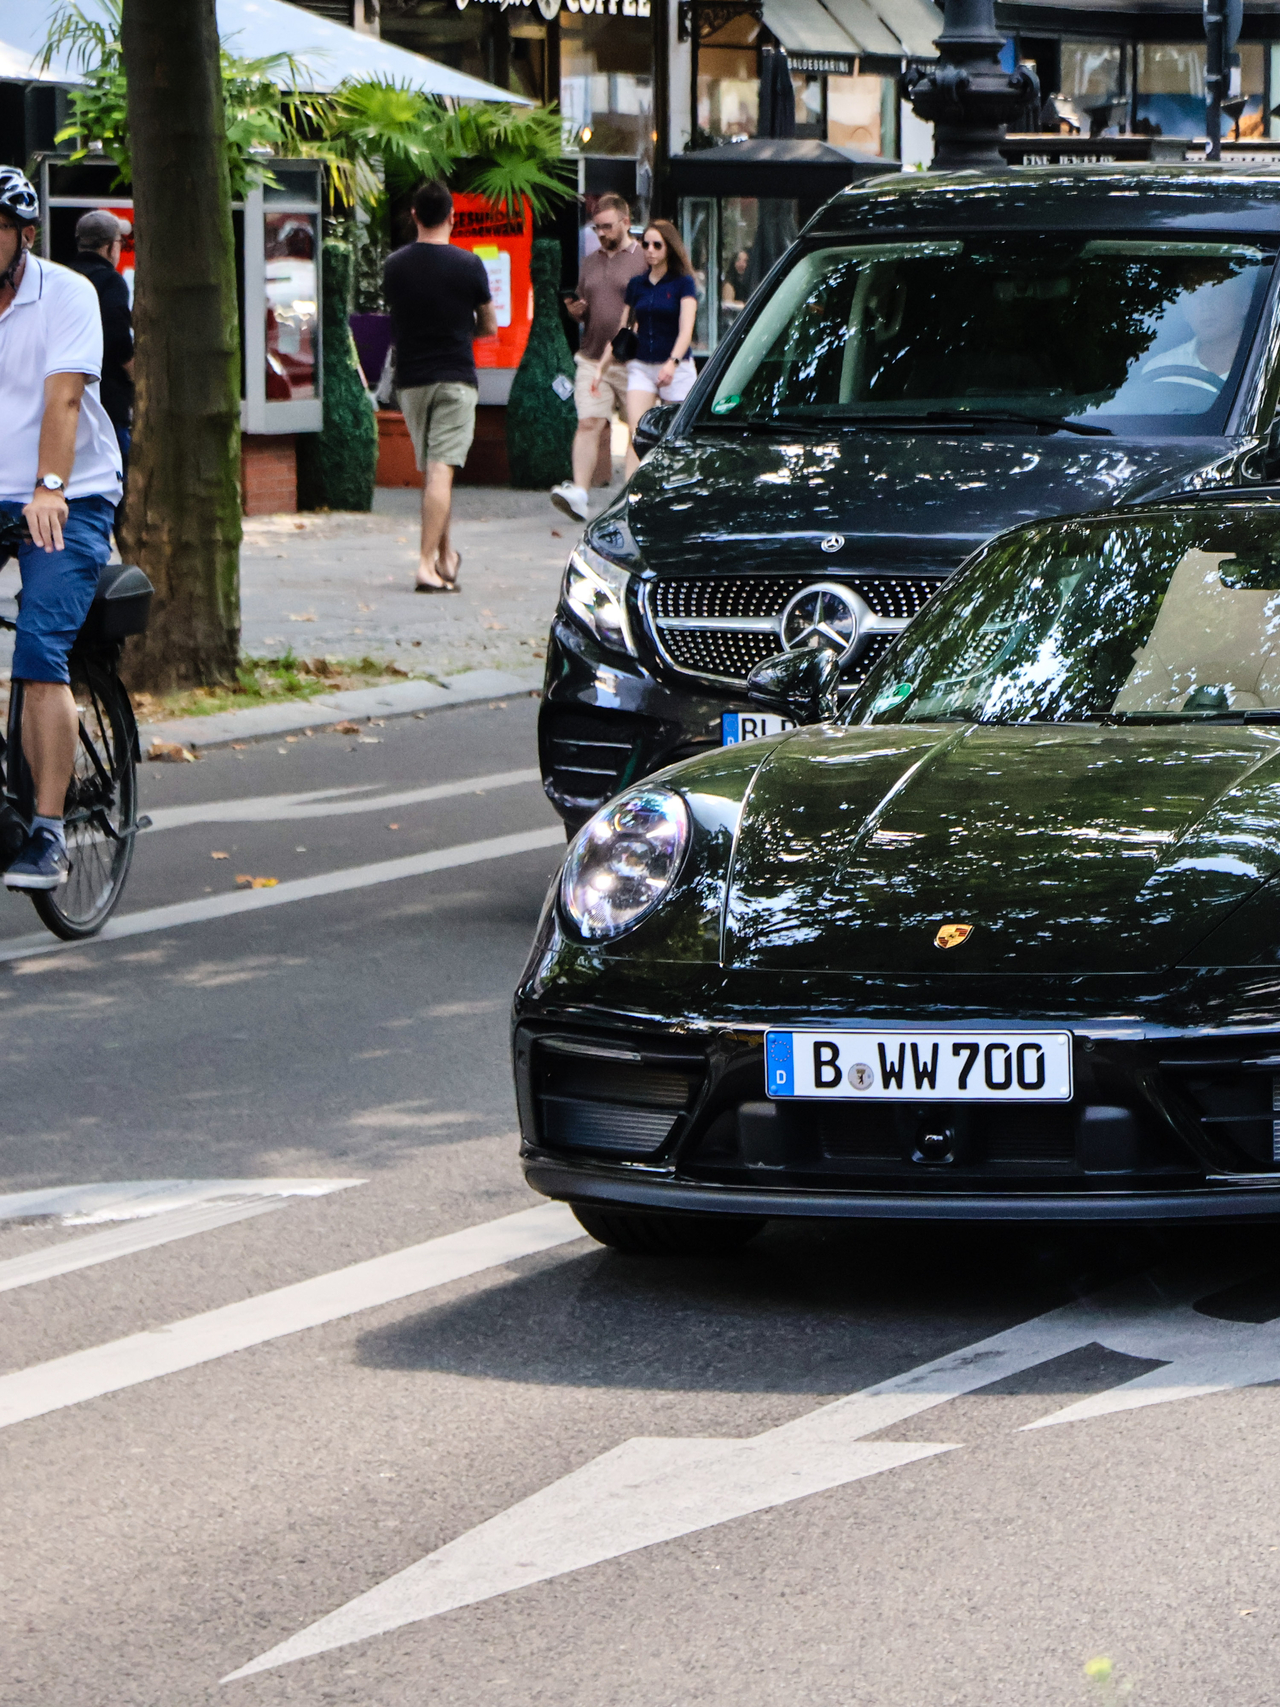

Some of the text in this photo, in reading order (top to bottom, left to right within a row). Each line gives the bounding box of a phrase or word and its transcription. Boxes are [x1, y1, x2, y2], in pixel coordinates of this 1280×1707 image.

[776, 1041, 1045, 1090] D B WW 700
